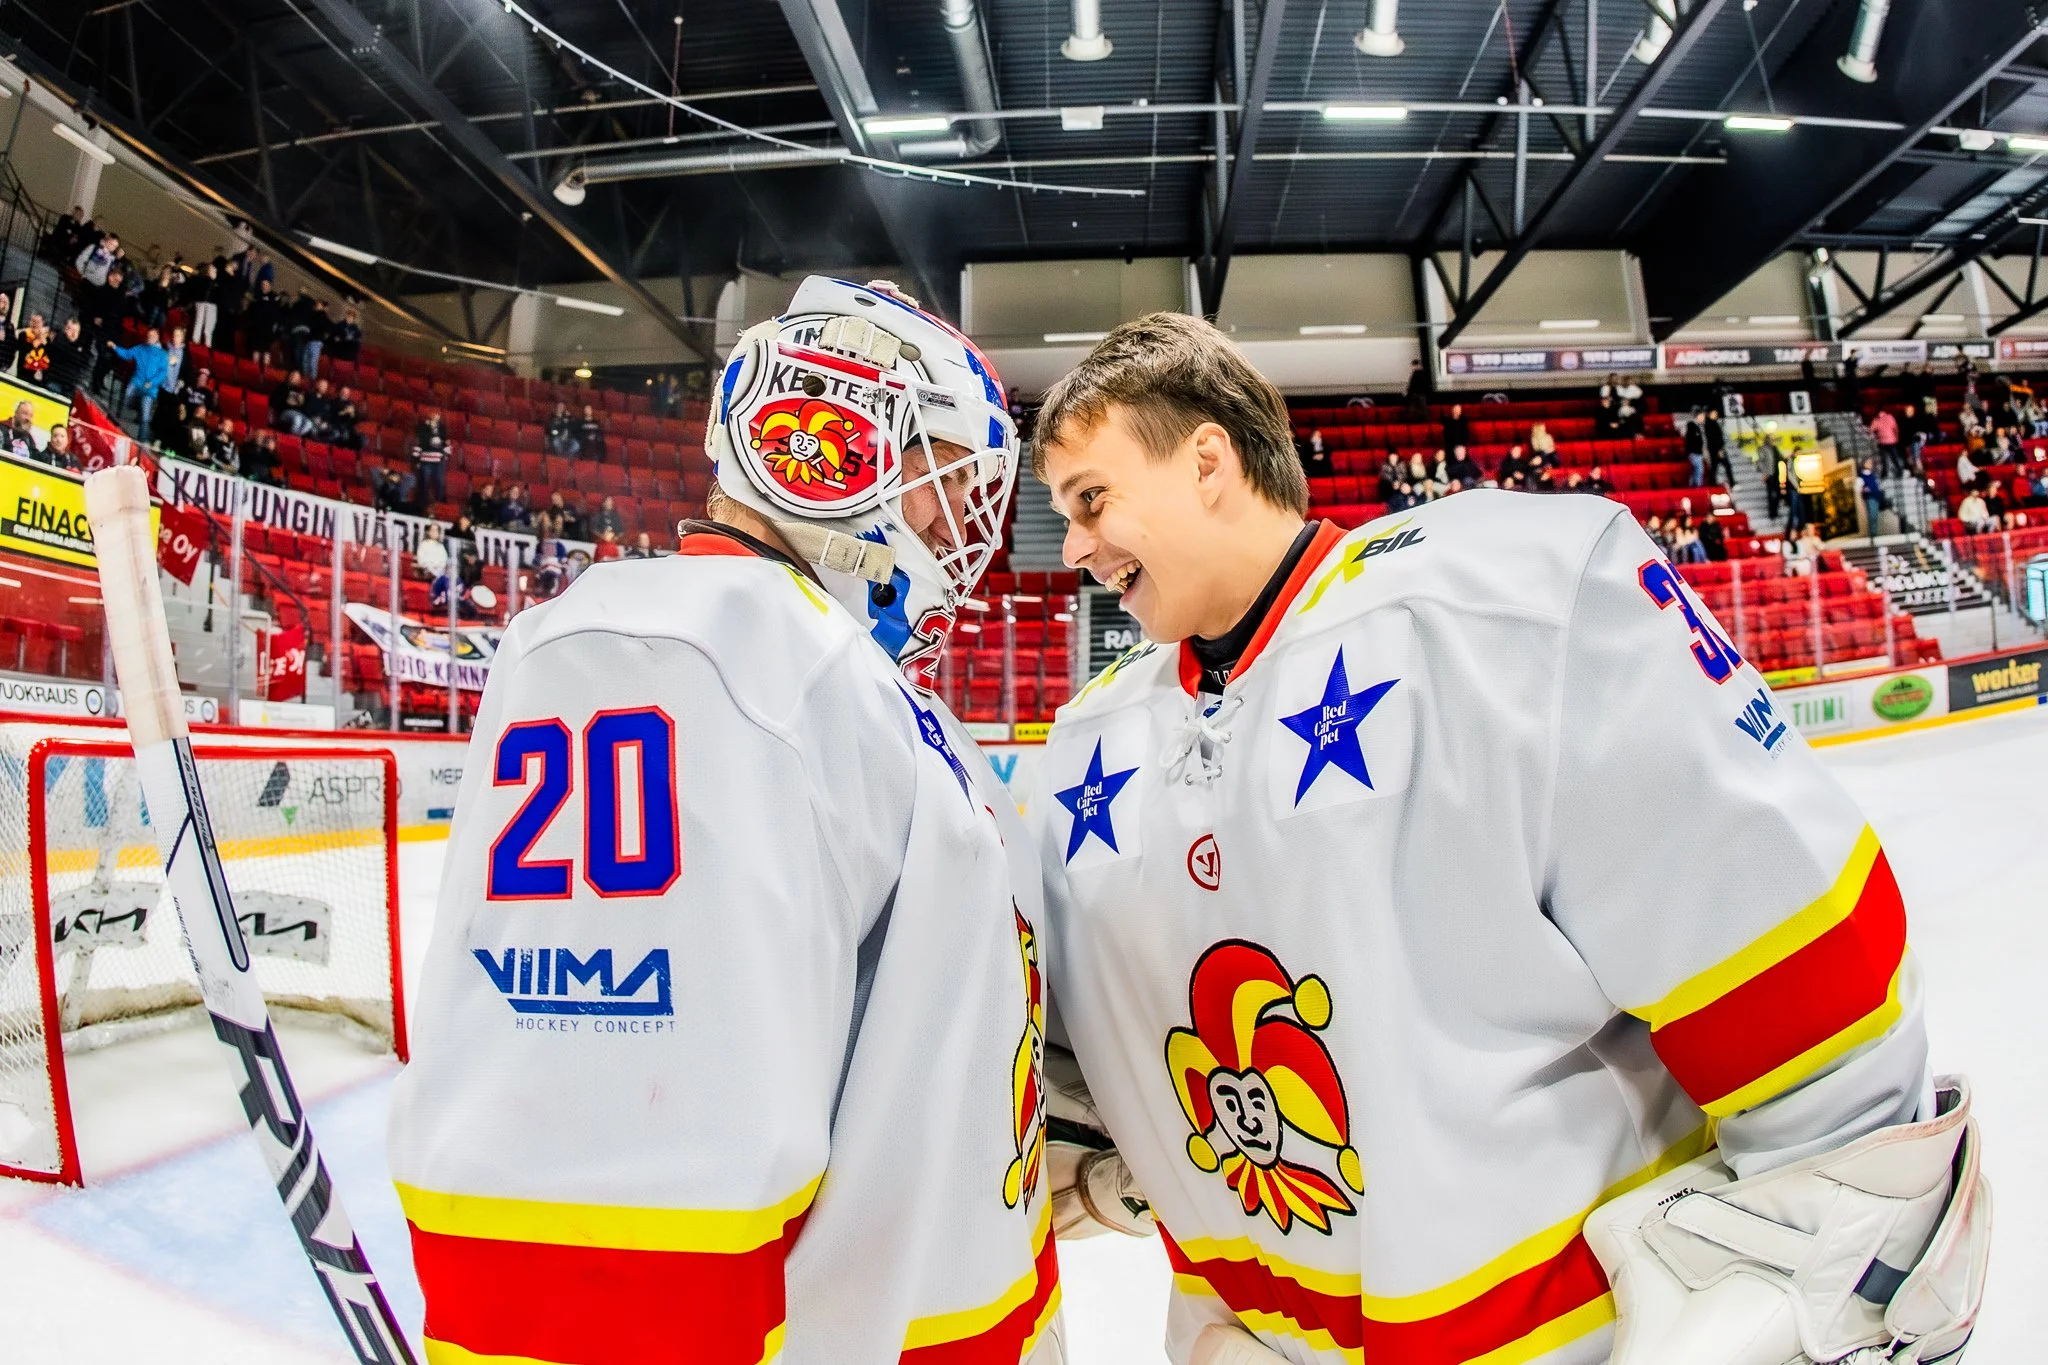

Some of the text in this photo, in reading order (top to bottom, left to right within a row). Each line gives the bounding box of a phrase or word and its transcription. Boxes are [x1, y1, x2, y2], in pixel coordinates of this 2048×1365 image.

[173, 467, 336, 540] KAUPUNGIN
[1972, 658, 2042, 694] worker
[1322, 699, 1347, 722] Red
[1320, 727, 1340, 750] pet
[1083, 781, 1103, 798] Red
[486, 705, 682, 901] 20
[1083, 803, 1098, 822] pet
[470, 947, 674, 1016] VIIMA
[515, 1017, 678, 1034] HOCKEY CONCEPT
